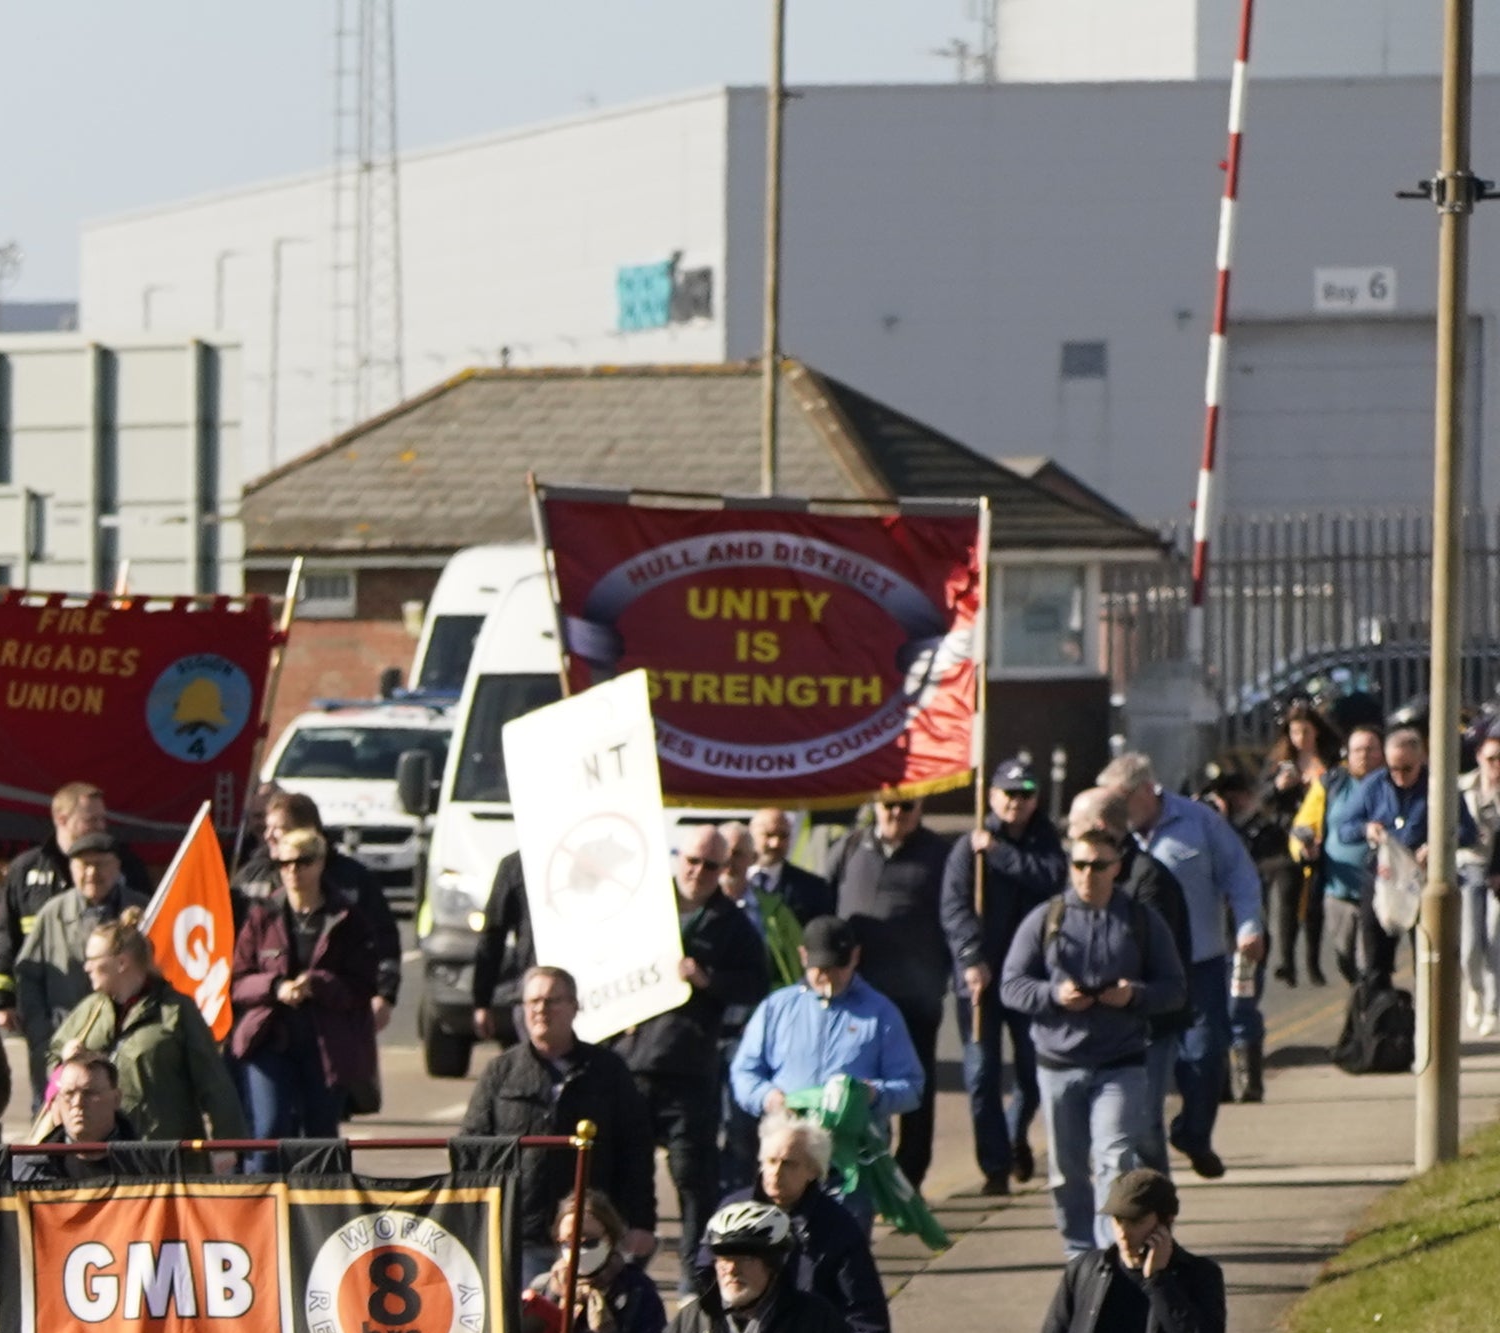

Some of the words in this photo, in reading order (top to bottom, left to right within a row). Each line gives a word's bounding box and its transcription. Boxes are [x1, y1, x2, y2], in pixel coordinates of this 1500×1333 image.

[1368, 271, 1388, 300] 6
[626, 546, 698, 587] HULL
[706, 541, 764, 564] AND
[774, 542, 899, 600] DISTRICT
[37, 608, 110, 635] FIRE
[686, 588, 831, 622] UNITY
[735, 631, 780, 663] IS
[6, 681, 104, 714] UNION
[647, 671, 883, 707] STRENGTH
[187, 736, 207, 760] 4
[703, 747, 797, 772] UNION
[805, 709, 905, 765] COUNC
[339, 1213, 448, 1254] WORK
[63, 1240, 254, 1323] GMB
[367, 1252, 422, 1325] 8
